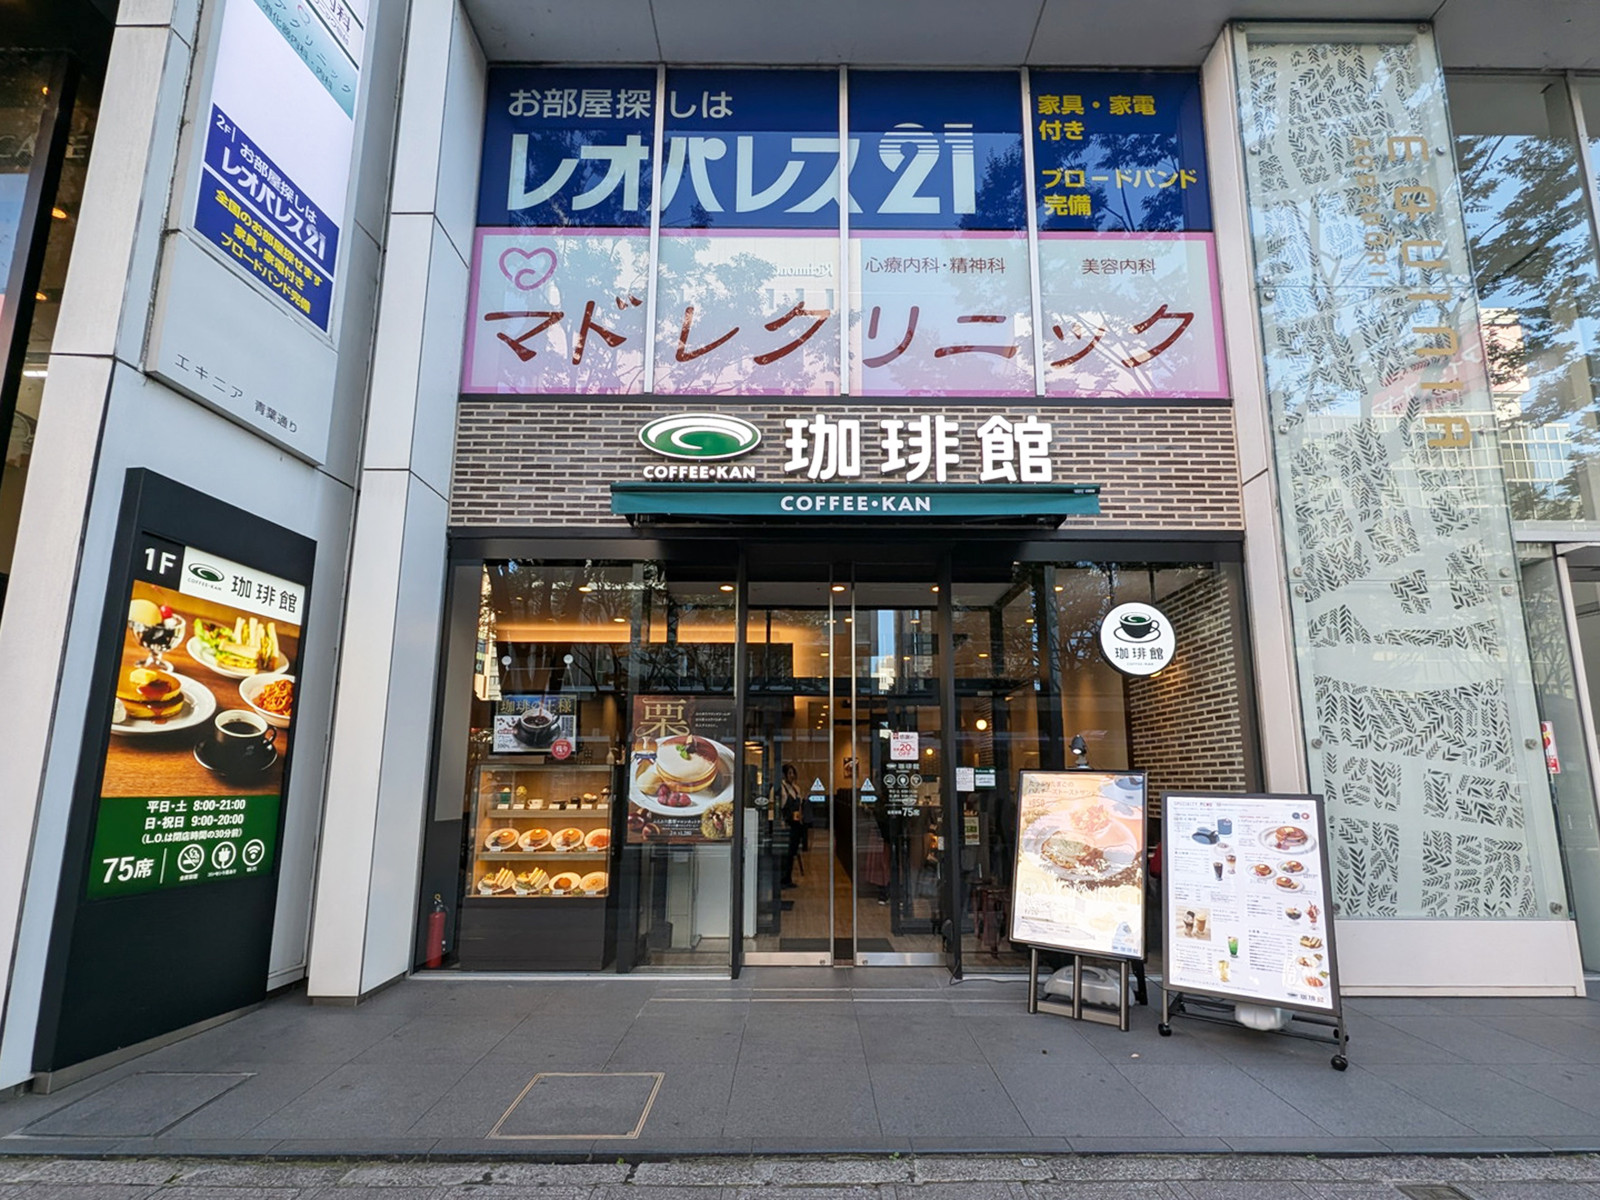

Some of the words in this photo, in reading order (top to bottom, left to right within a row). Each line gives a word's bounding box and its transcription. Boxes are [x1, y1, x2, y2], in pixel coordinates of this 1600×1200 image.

[508, 88, 734, 119] お部屋探しは
[1038, 95, 1156, 116] 家具・家電
[216, 114, 232, 134] 2F
[1039, 120, 1085, 141] 付き
[507, 123, 976, 214] レオパレス21
[1041, 168, 1197, 189] ブロードバンド
[239, 143, 318, 224] お部屋探しは
[221, 147, 326, 260] レオパレス21
[1043, 195, 1091, 216] 完備
[215, 189, 323, 287] 全国のお部屋探せます
[233, 223, 305, 290] 家具・家電付き
[865, 256, 1006, 274] 心療内科・精神科
[1082, 258, 1157, 275] 美容内科
[220, 232, 311, 314] ブロードバンド完備
[175, 354, 243, 398] エキニア
[254, 399, 298, 433] 青葉通り
[784, 414, 1053, 483] 珈琲館
[144, 547, 177, 575] 1F
[230, 575, 298, 614] 珈琲館
[1114, 647, 1164, 660] 珈琲館
[635, 697, 690, 737] 栗
[146, 800, 188, 813] 平日・土
[193, 799, 246, 811] 8:00-21:00
[144, 816, 185, 830] 日・祝日
[191, 813, 244, 827] 9:00-20:00
[102, 856, 155, 884] 75席
